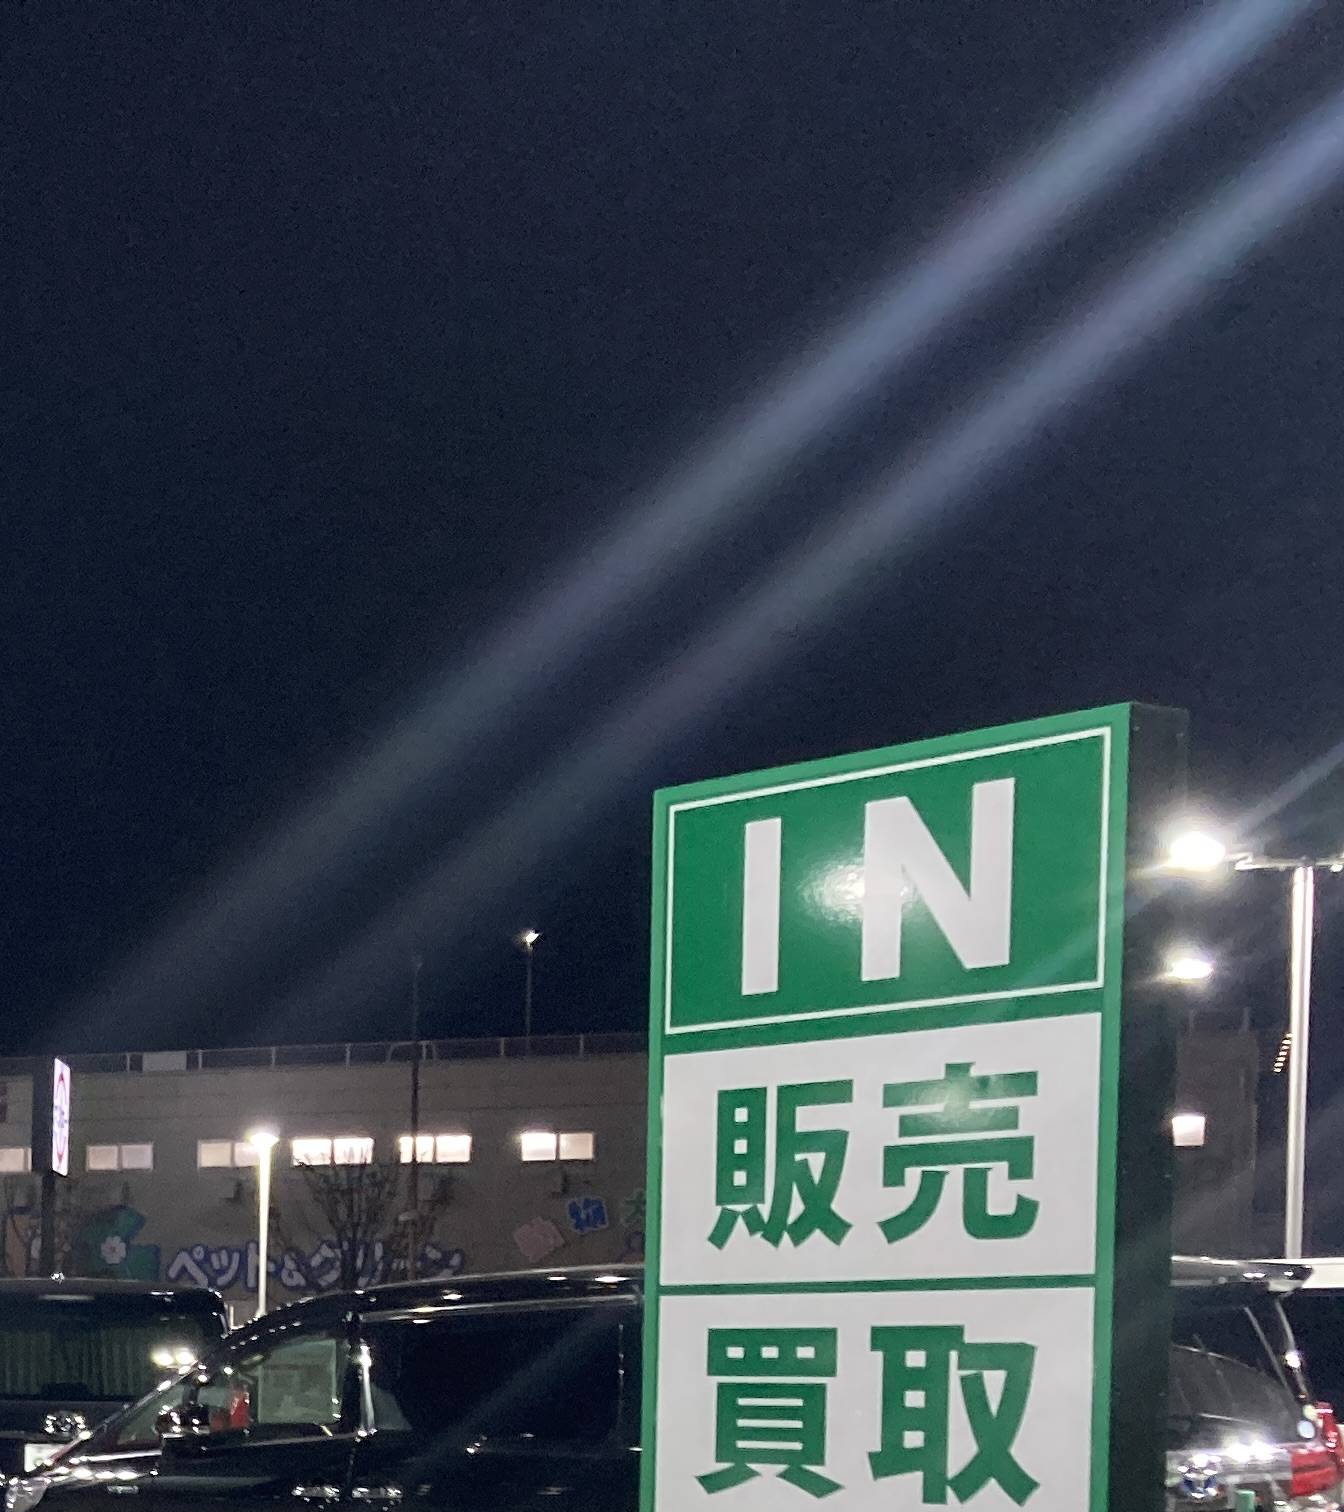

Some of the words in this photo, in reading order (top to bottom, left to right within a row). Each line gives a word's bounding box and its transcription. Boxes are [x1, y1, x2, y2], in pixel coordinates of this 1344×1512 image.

[742, 777, 1015, 996] IN
[706, 1061, 1040, 1251] 販売
[694, 1324, 1040, 1507] 買取
